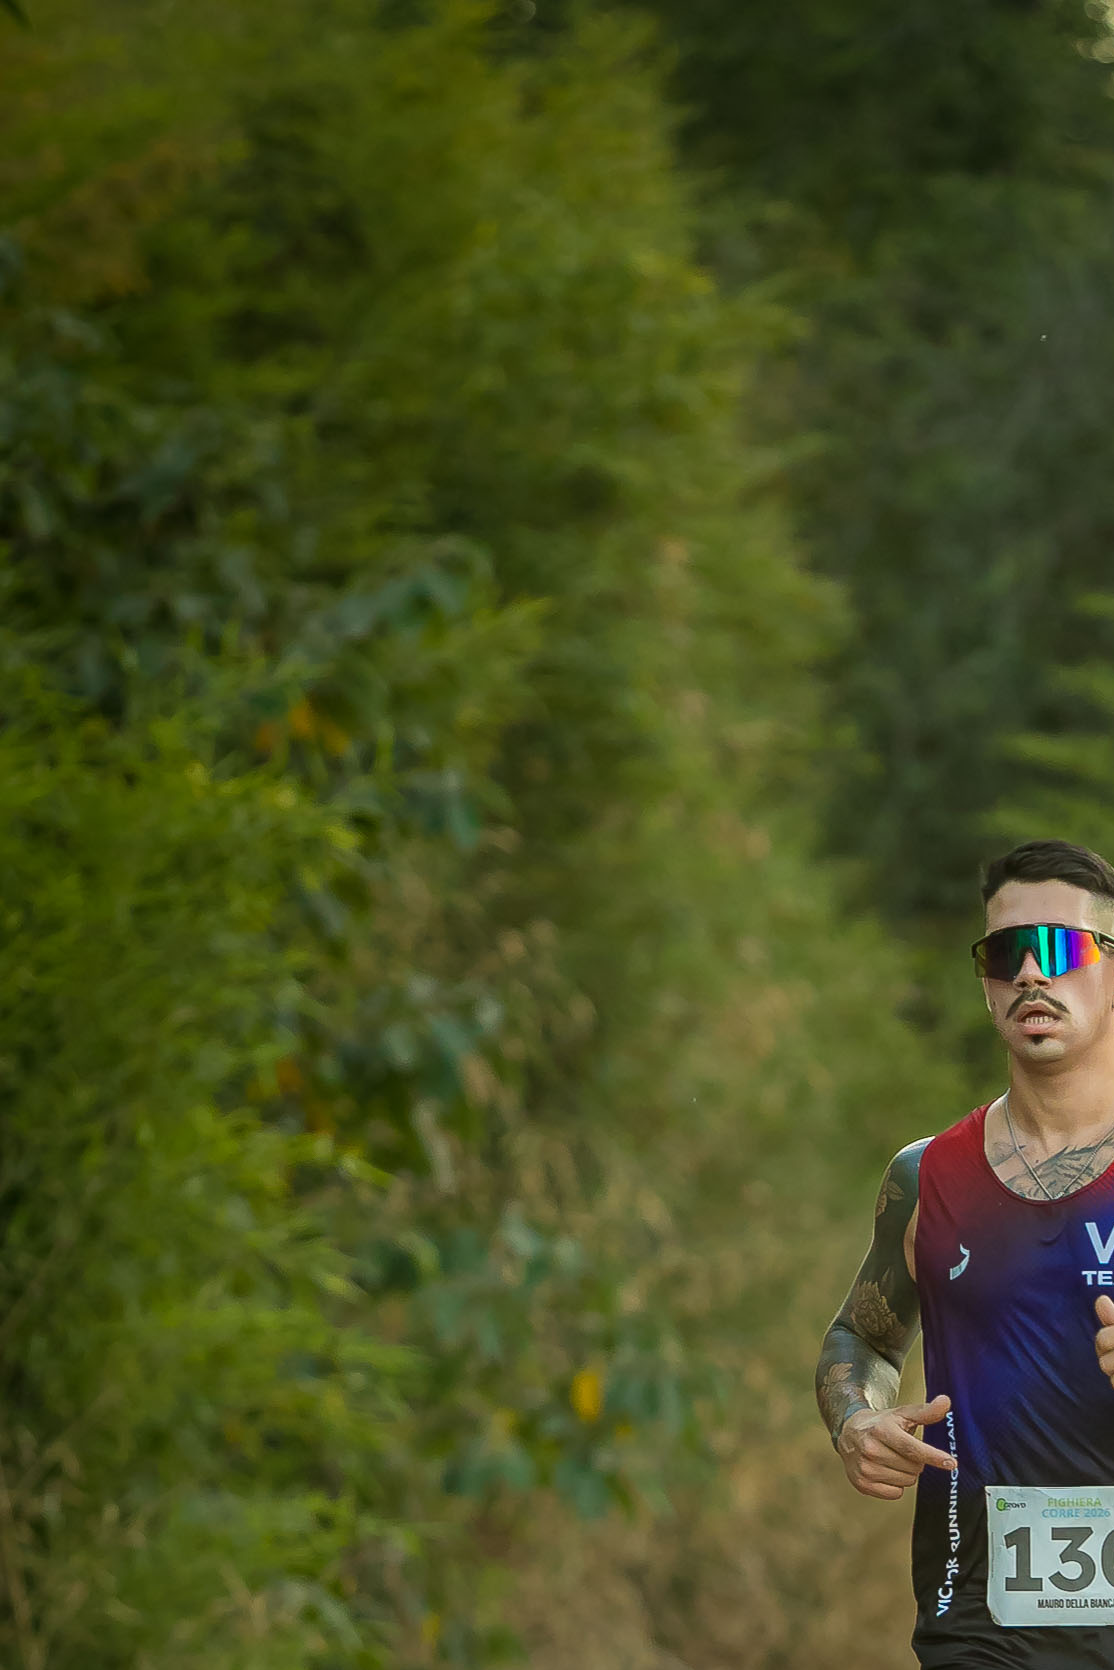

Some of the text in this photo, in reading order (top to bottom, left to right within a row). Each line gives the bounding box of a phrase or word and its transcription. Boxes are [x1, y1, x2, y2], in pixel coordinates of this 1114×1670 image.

[1047, 1497, 1102, 1507] FIGHIERA
[1041, 1508, 1081, 1518] CORRE
[1037, 1599, 1064, 1608] MAURO
[1065, 1598, 1089, 1608] DELLA
